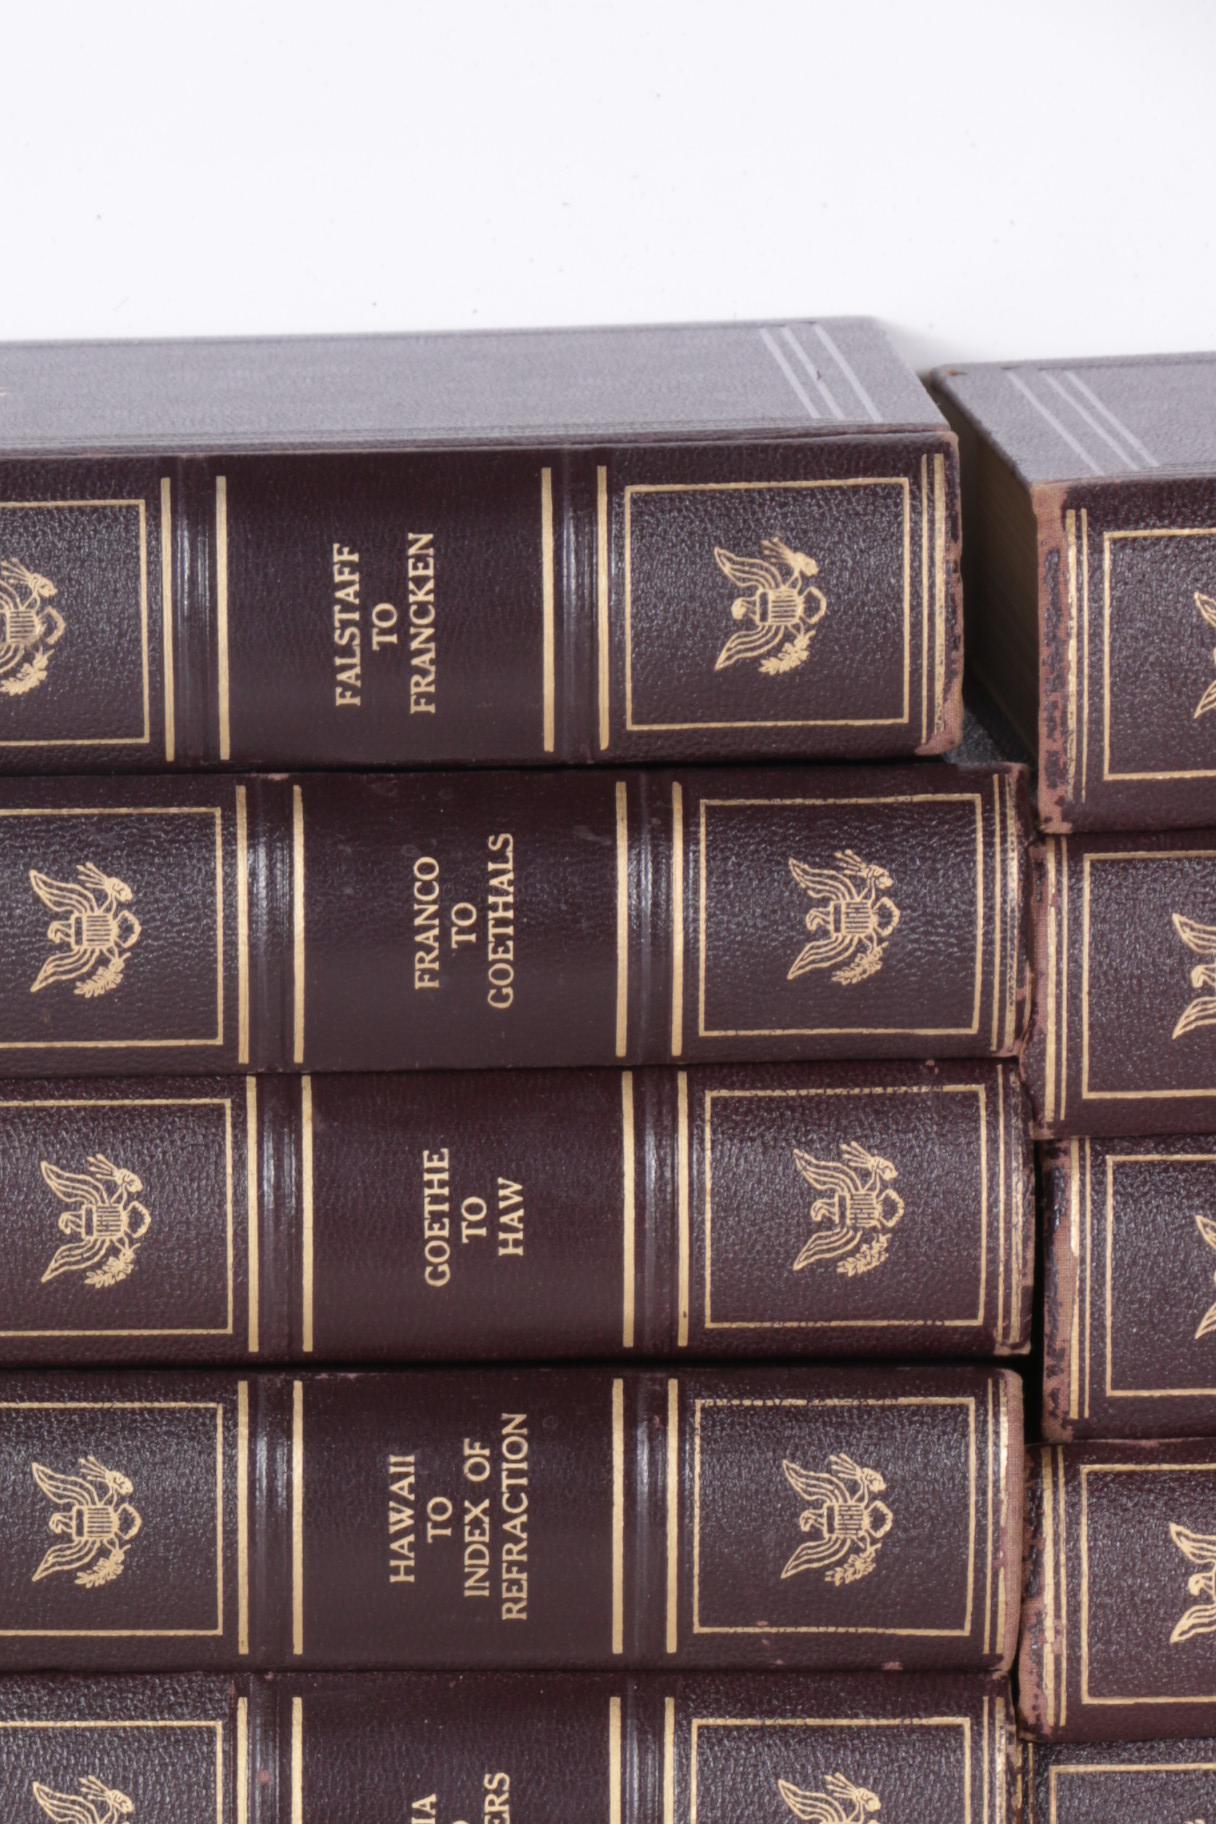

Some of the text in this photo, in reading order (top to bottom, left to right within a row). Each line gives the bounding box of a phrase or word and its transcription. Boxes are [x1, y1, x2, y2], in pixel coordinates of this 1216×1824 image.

[333, 543, 361, 706] FALSTAFF
[372, 602, 399, 650] TO
[408, 532, 436, 714] FRANCKEN
[415, 856, 440, 990] FRANCO
[451, 901, 477, 949] TO
[487, 833, 514, 1009] GOETHALS
[423, 1148, 451, 1287] GOETHE
[461, 1196, 488, 1244] TO
[497, 1177, 524, 1256] HAW
[389, 1455, 415, 1583] HAWAII
[427, 1496, 453, 1543] TO
[464, 1438, 491, 1597] INDEX OF
[501, 1413, 529, 1620] REFRACTION
